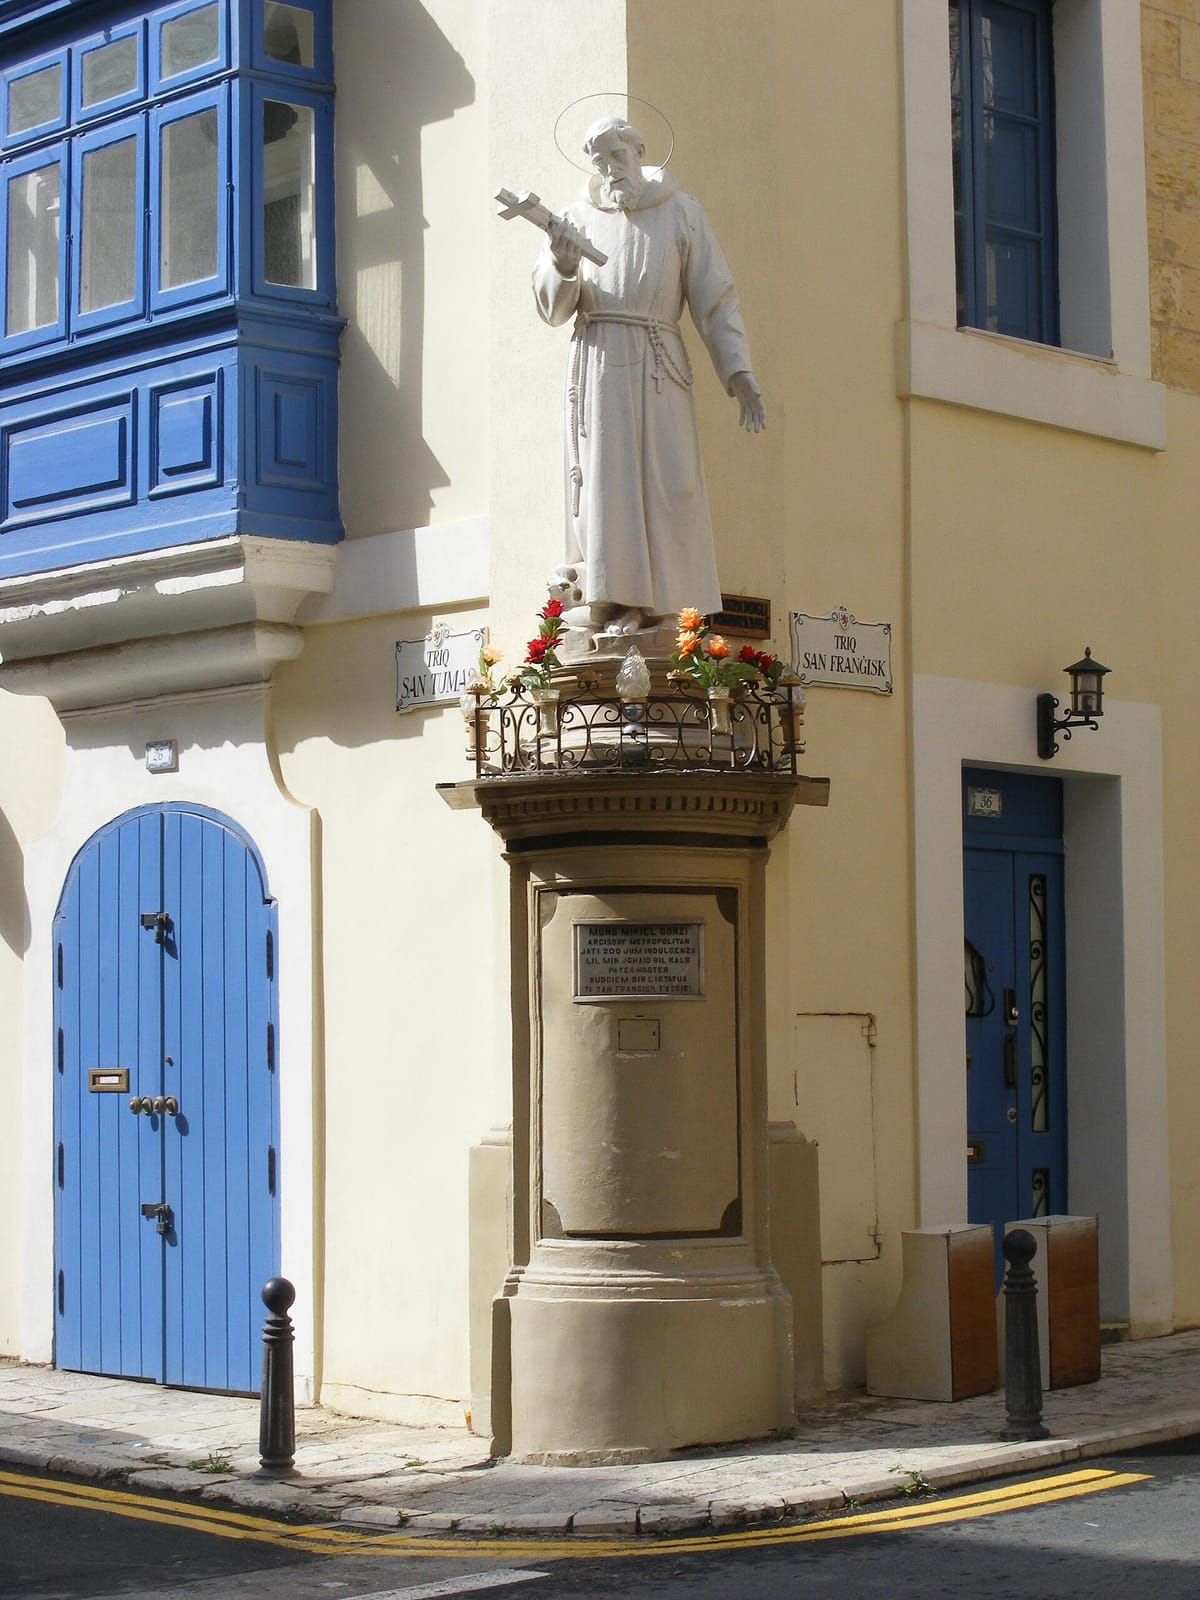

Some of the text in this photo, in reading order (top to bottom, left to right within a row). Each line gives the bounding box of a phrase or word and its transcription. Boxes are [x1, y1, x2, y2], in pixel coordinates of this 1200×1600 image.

[834, 635, 857, 653] TRIQ
[427, 648, 450, 667] TRIQ
[803, 652, 827, 670] SAN
[401, 674, 427, 699] SAN
[980, 795, 993, 809] 36
